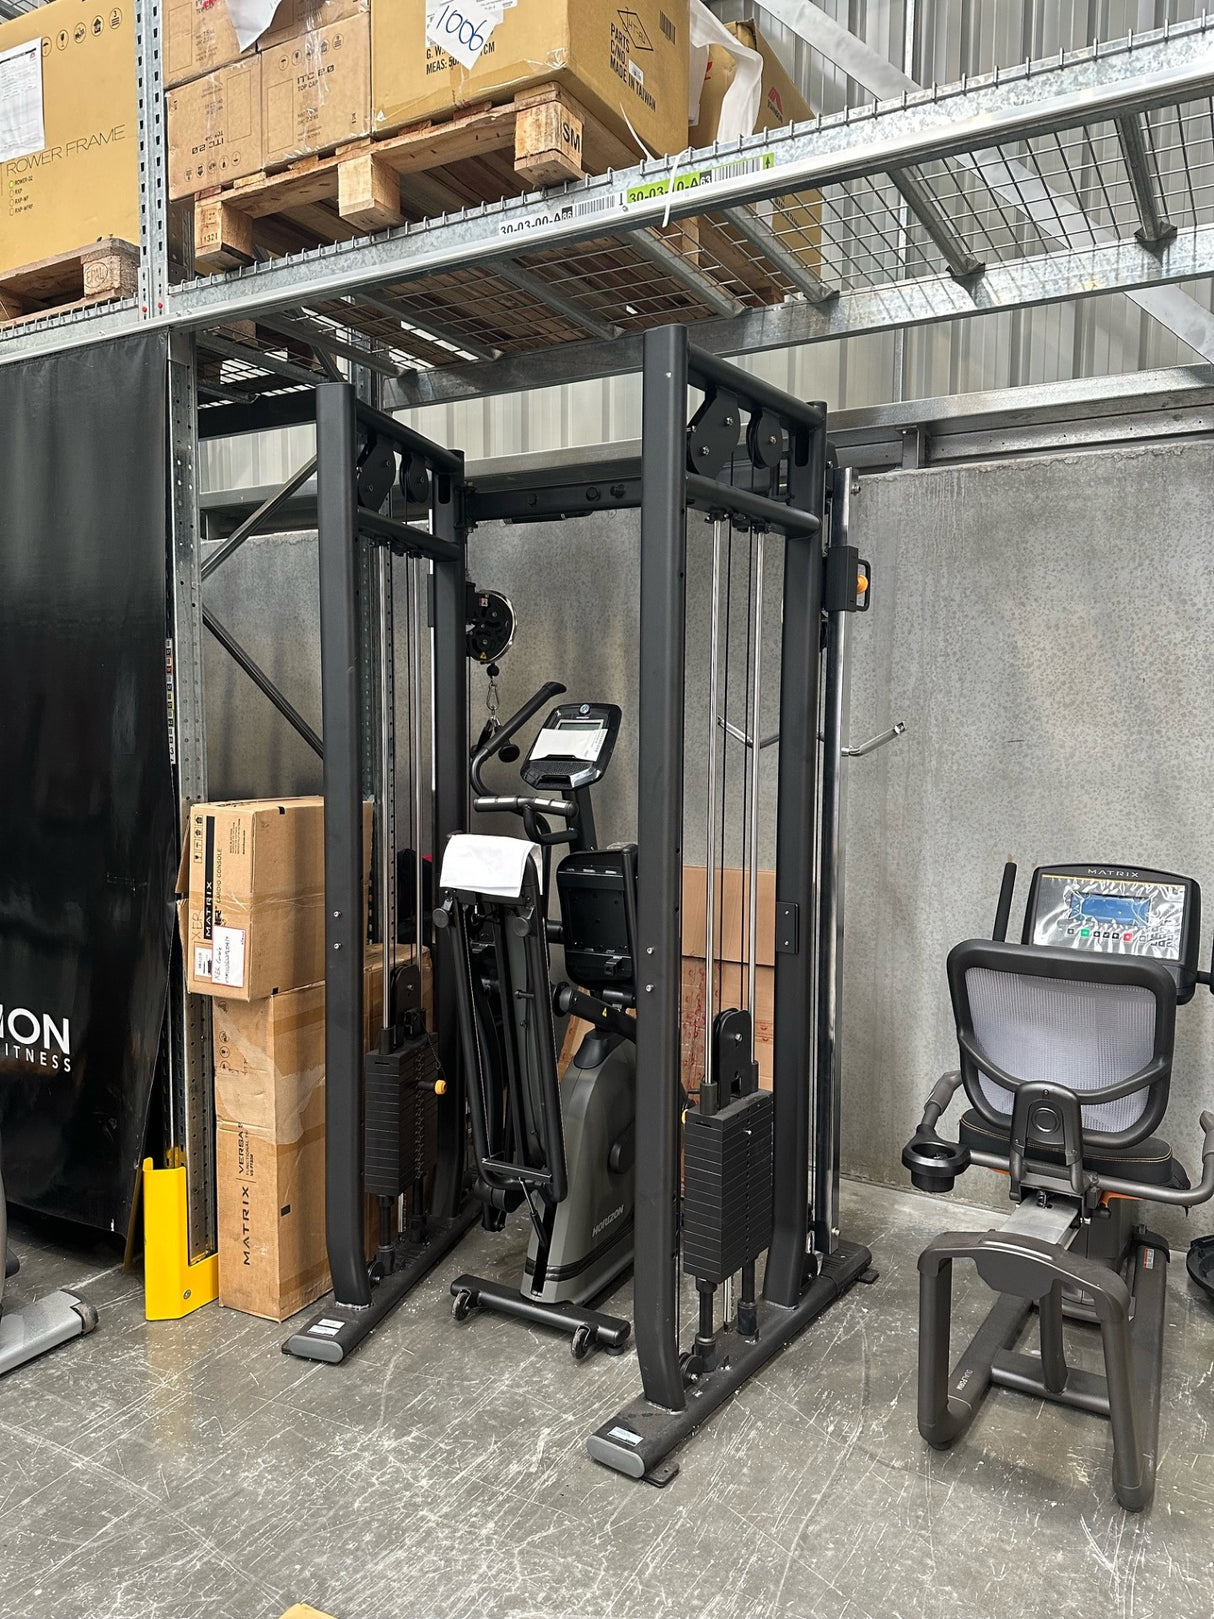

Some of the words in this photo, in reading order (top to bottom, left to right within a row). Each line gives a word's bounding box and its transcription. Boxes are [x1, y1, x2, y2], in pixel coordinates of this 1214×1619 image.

[436, 5, 487, 51] 1006
[610, 22, 630, 53] PARTS
[297, 71, 315, 84] ITC
[426, 58, 447, 75] MEAS:
[610, 55, 627, 83] MADE
[636, 81, 656, 112] TAIWAN
[6, 146, 63, 176] ROWER
[65, 124, 126, 156] FRAME
[562, 122, 580, 153] SM
[1087, 868, 1139, 878] MATRIX
[205, 881, 213, 937] MATRIX
[242, 1186, 251, 1265] MATRIX
[591, 1203, 624, 1238] HORIZON
